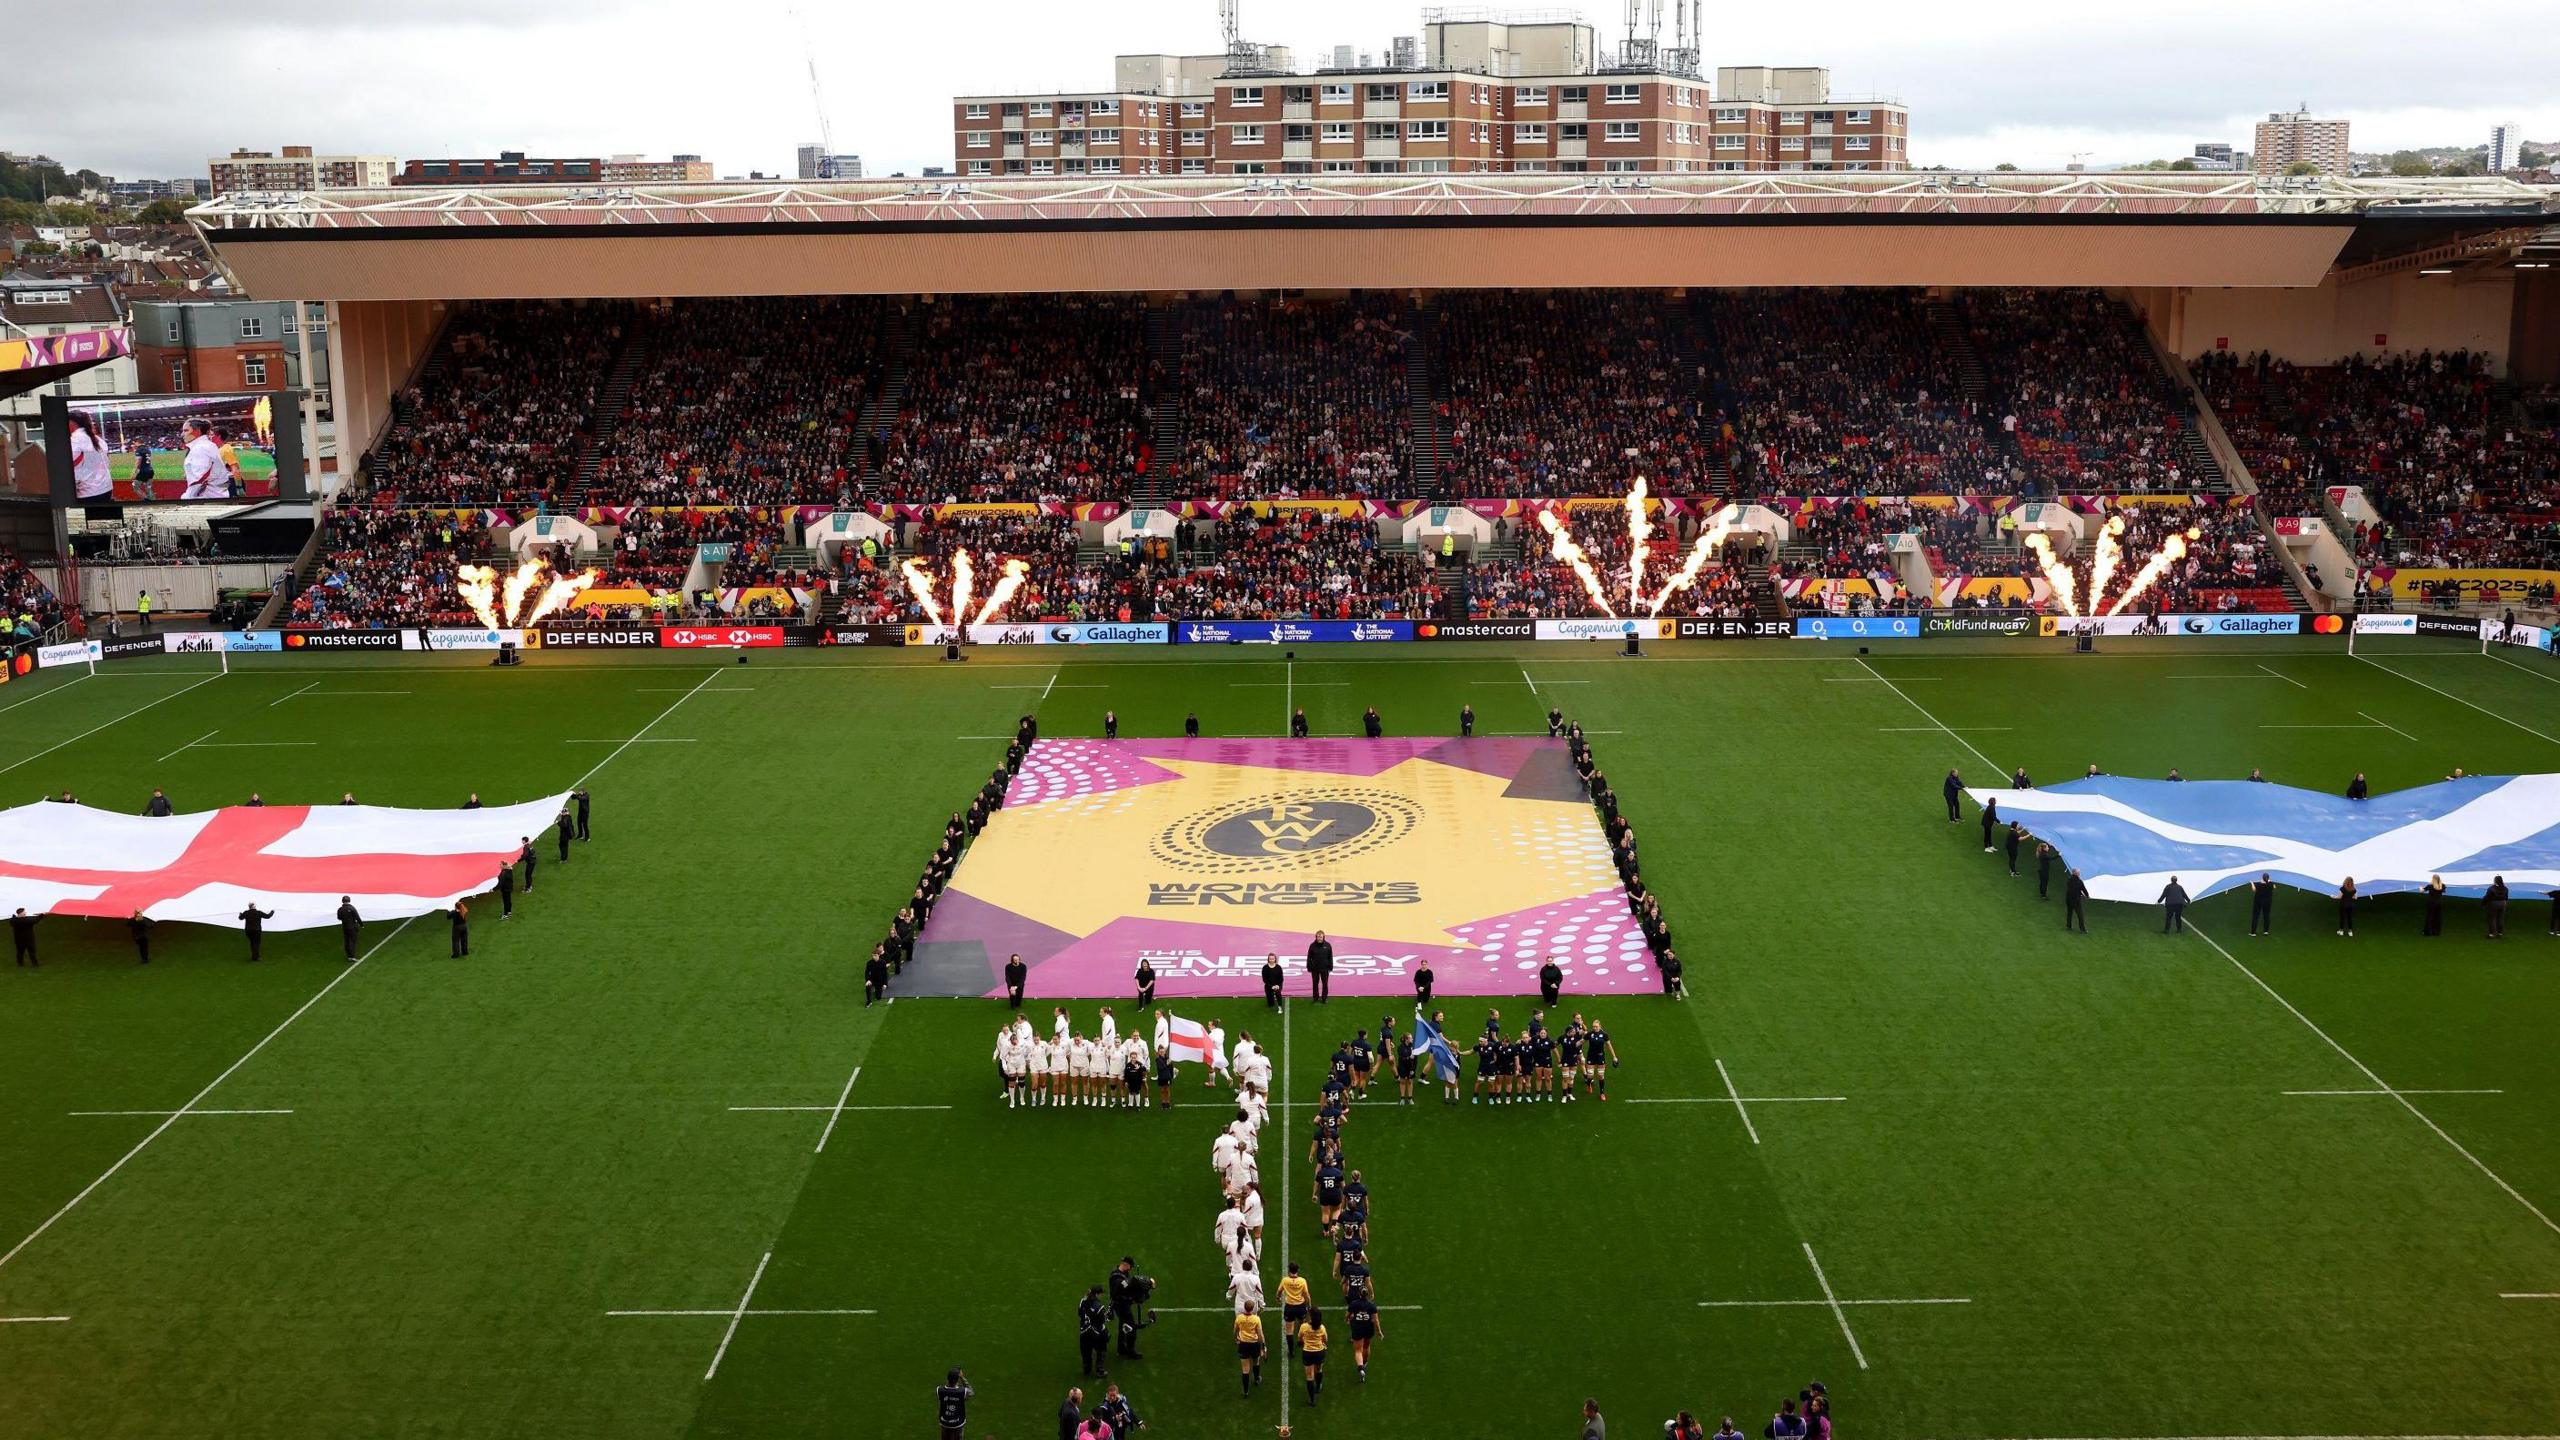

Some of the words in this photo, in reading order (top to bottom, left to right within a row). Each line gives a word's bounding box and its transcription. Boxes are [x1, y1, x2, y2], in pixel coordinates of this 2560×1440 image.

[2285, 519, 2299, 528] A9
[713, 546, 728, 555] A11
[2407, 580, 2528, 591] #RC2025
[1441, 623, 1530, 636] mastercard
[1558, 620, 1622, 638] Capgemini
[1990, 621, 2027, 631] RUGBY
[2220, 618, 2293, 634] Gallagher
[2419, 621, 2478, 632] DEFENDER
[309, 633, 397, 646] mastercard
[546, 631, 655, 645] DEFENDER
[998, 630, 1034, 644] Asahi
[1087, 627, 1161, 642] Gallagher
[104, 639, 162, 653] DEFENDER
[177, 638, 213, 652] Asahi
[232, 643, 273, 652] Gallagher
[1149, 882, 1422, 892] WOMEN'S
[1147, 892, 1423, 905] ENG25
[1354, 1049, 1364, 1057] 12
[1336, 1062, 1346, 1071] 13
[1323, 1179, 1335, 1188] 18
[1343, 1253, 1354, 1262] 21
